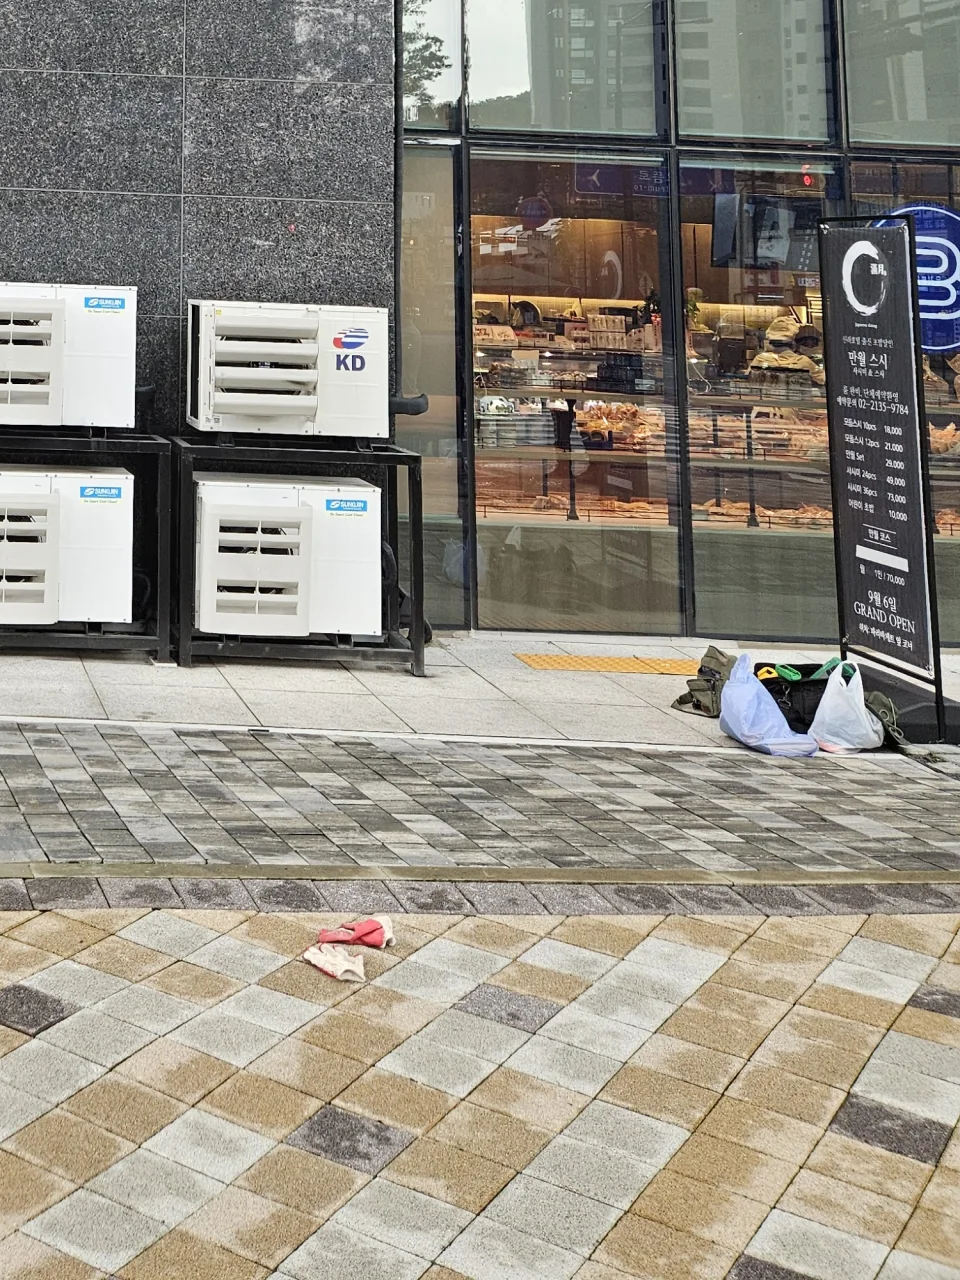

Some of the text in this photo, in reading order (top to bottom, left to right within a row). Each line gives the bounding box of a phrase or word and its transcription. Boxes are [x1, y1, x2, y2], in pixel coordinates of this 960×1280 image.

[336, 354, 366, 372] KD
[869, 353, 888, 370] 스시
[858, 398, 909, 416] 02-2135-9784
[867, 590, 897, 613] 9월 6일
[853, 601, 916, 635] GRAND OPEN
